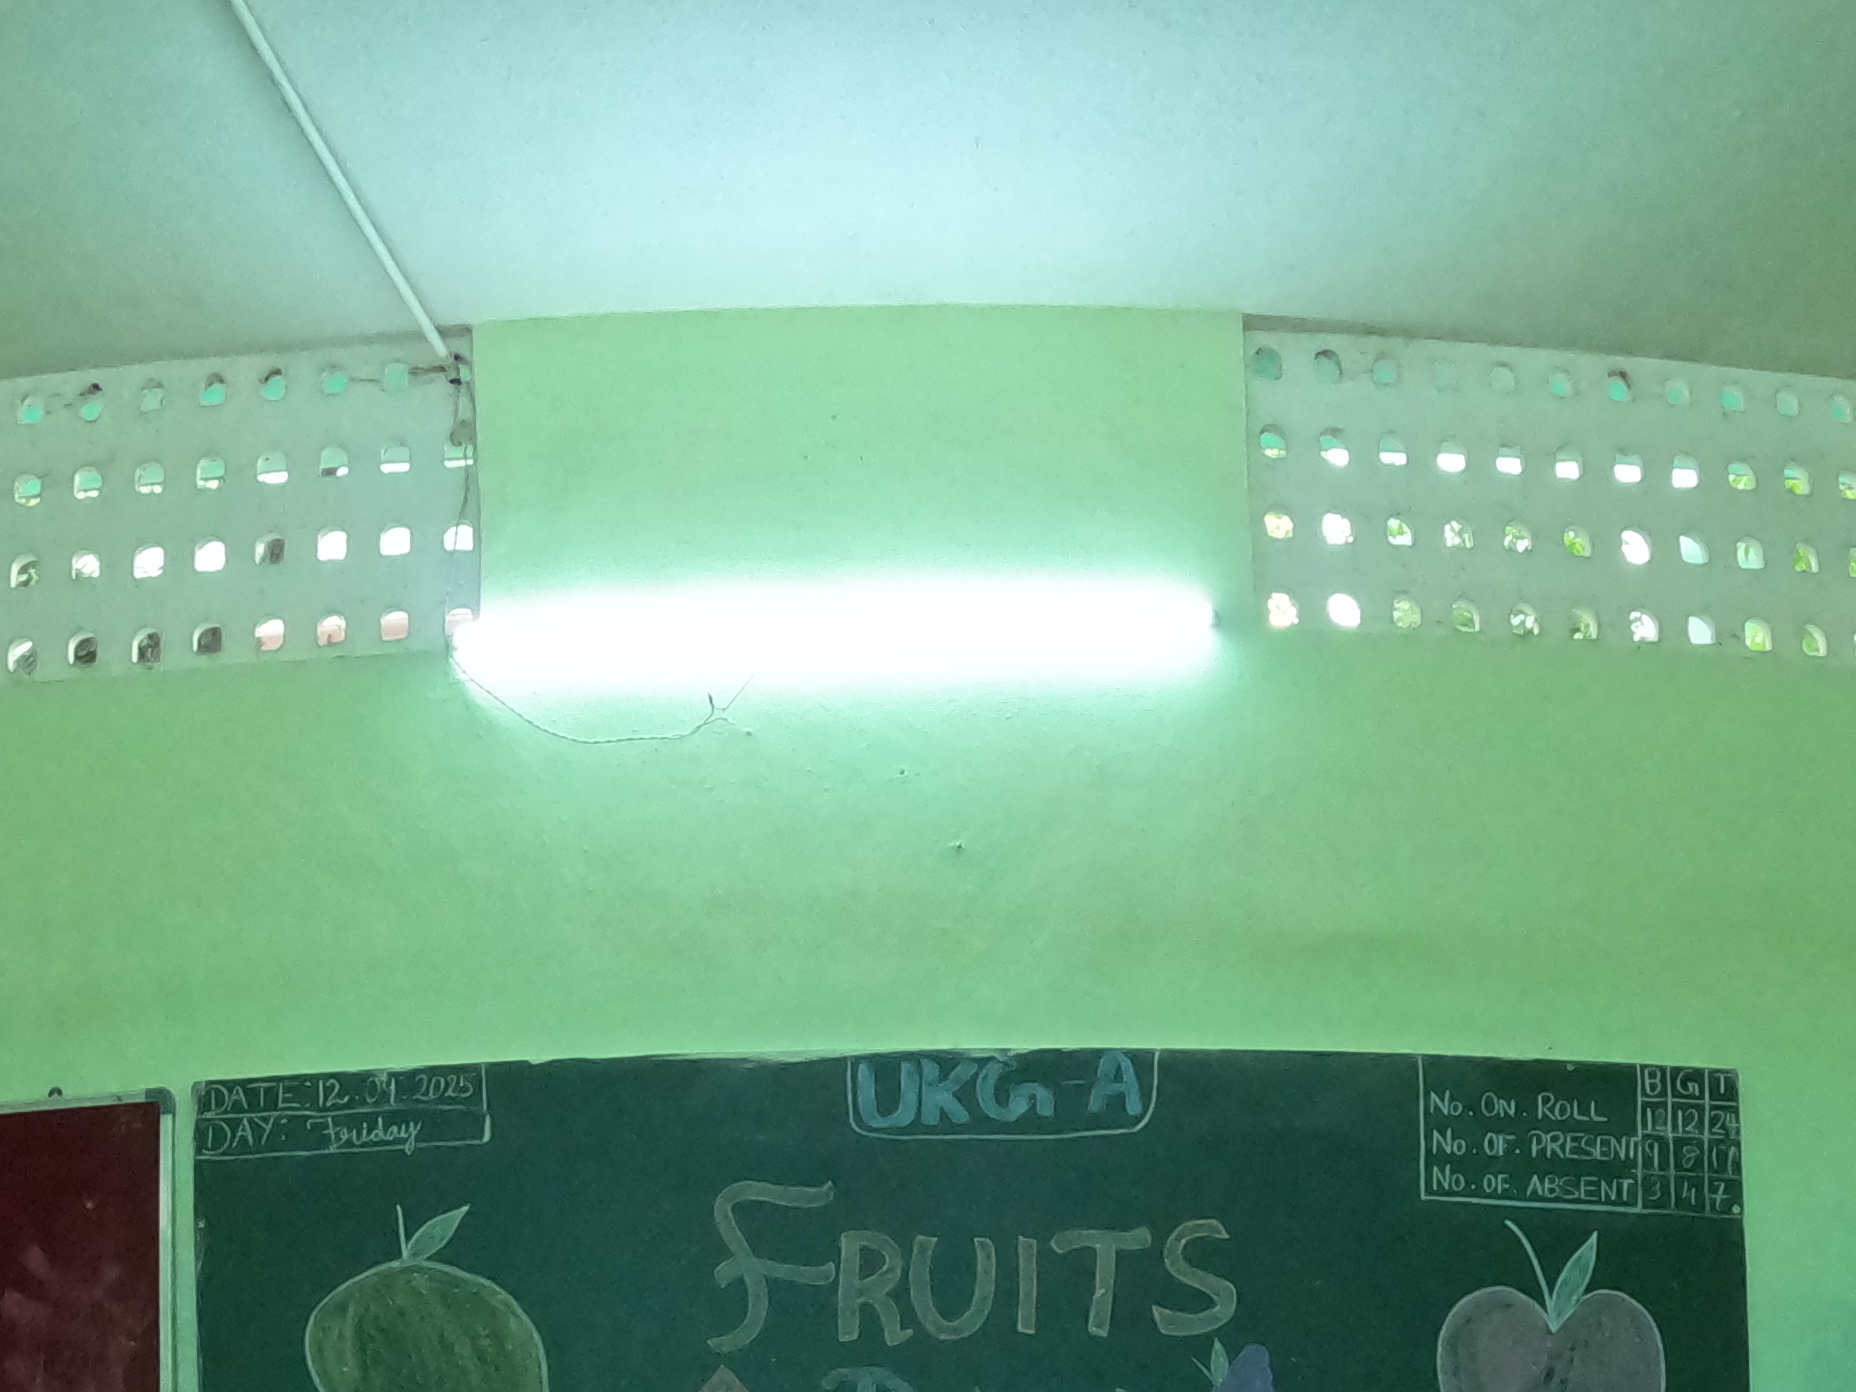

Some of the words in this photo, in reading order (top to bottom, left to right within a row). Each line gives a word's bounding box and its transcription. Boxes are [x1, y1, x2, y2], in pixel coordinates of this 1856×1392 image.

[1644, 1066, 1663, 1096] B
[1676, 1069, 1700, 1097] G
[1713, 1072, 1734, 1095] T
[1536, 1091, 1609, 1122] ROLL
[1678, 1108, 1699, 1134] 12
[1681, 1140, 1701, 1169] 8
[1526, 1173, 1636, 1202] ABSENT
[703, 1177, 1240, 1354] FRUITS
